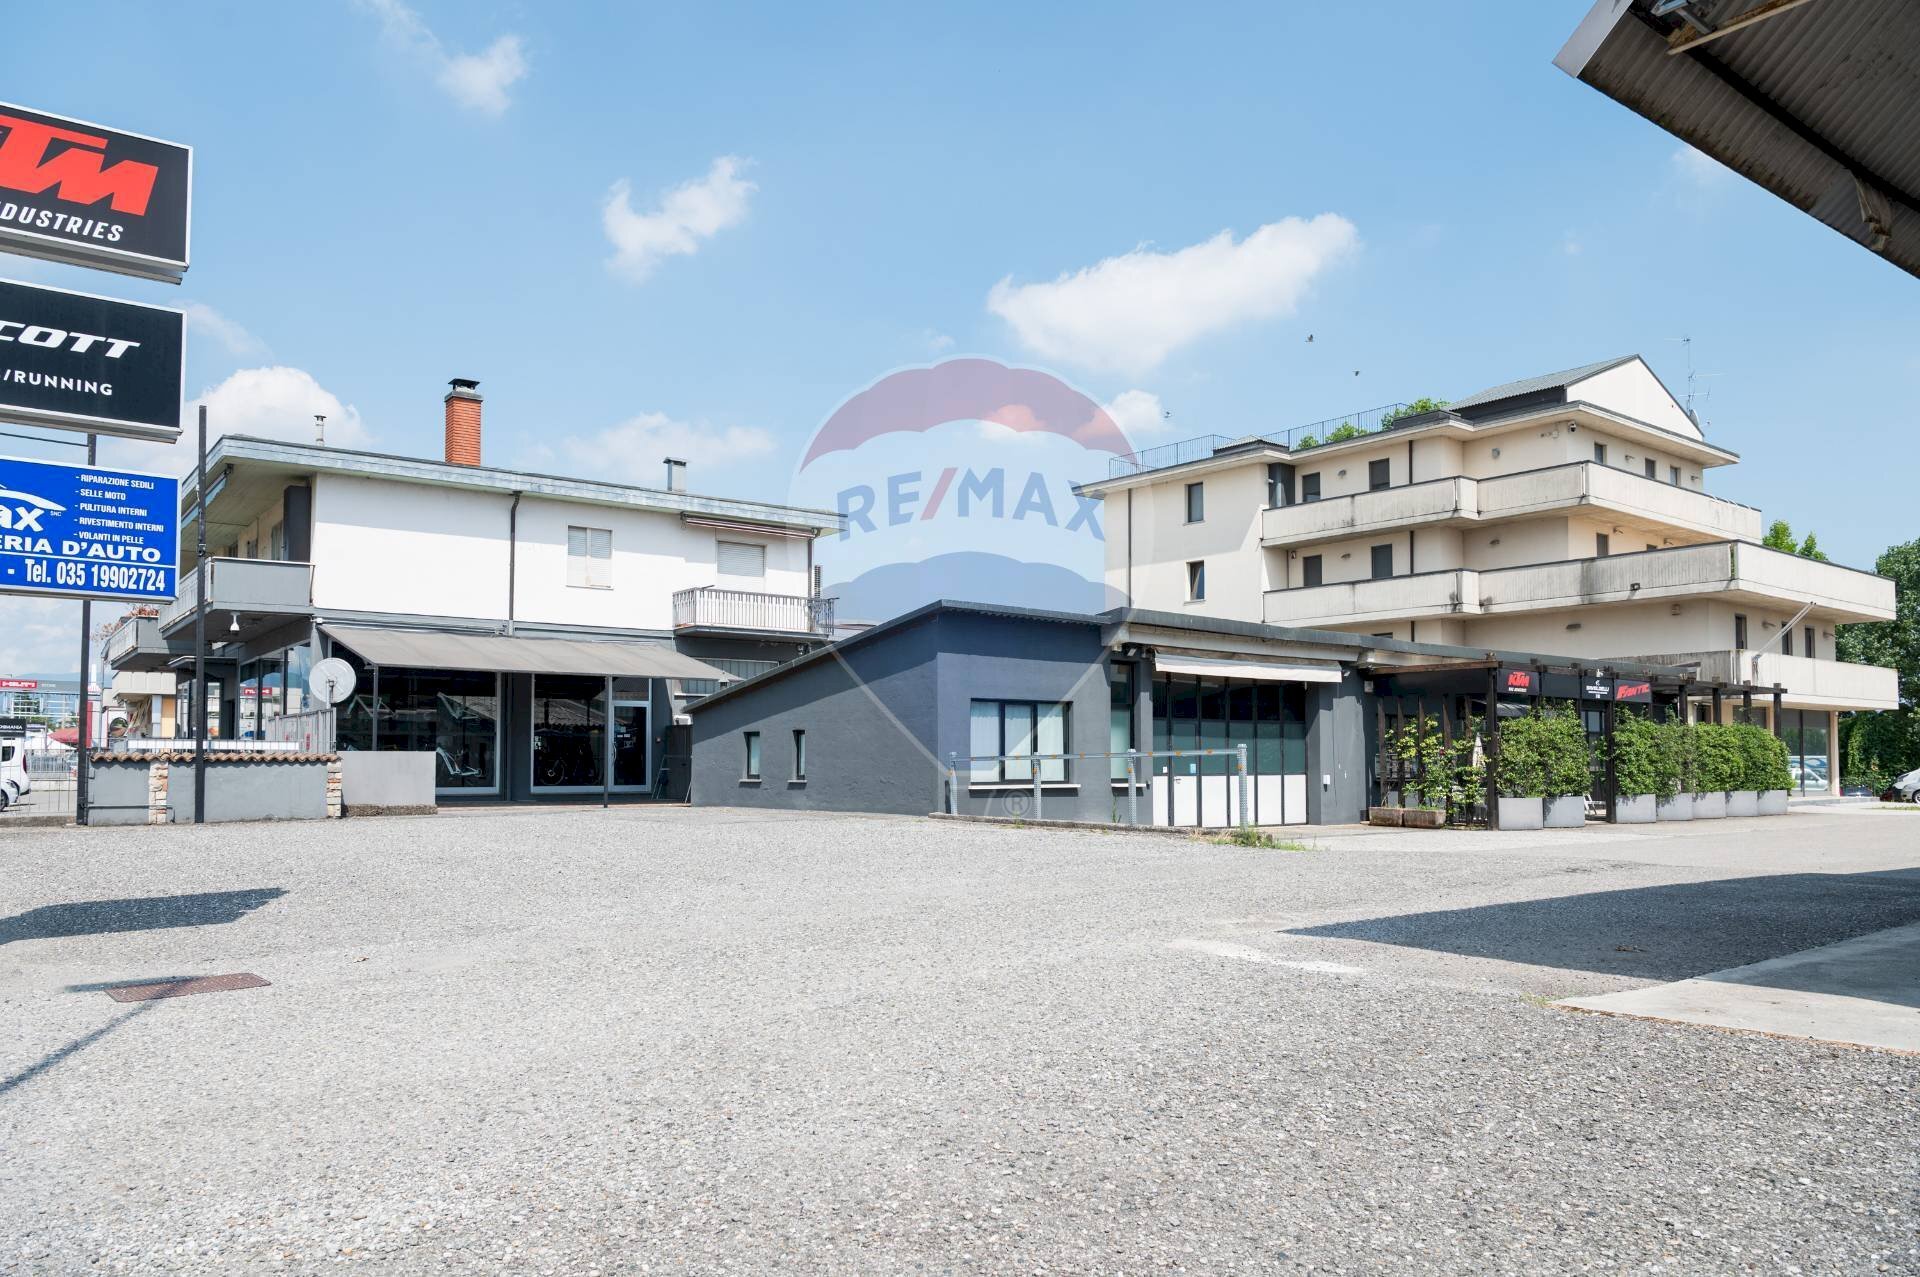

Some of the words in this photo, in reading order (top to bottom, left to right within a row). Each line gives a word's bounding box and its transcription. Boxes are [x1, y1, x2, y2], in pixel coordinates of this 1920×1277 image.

[0, 114, 159, 217] TM
[0, 201, 125, 242] DUSTRIES
[0, 369, 113, 396] /RUNNING
[80, 474, 129, 487] RIPARAZIONE
[131, 480, 154, 489] SEDILI
[80, 489, 103, 497] SELLE
[105, 491, 126, 500] MOTO
[80, 503, 116, 514] PULITURA
[118, 507, 147, 516] INTERNI
[79, 517, 133, 529] RIVESTIMENTO
[135, 523, 163, 532] INTERNI
[0, 535, 53, 554] RIA
[62, 541, 161, 562] D'AUTO
[79, 532, 110, 541] VOLANTI
[122, 536, 144, 544] PELLE
[25, 559, 51, 583] Tel.
[57, 562, 85, 586] 035
[91, 565, 165, 591] 19902724
